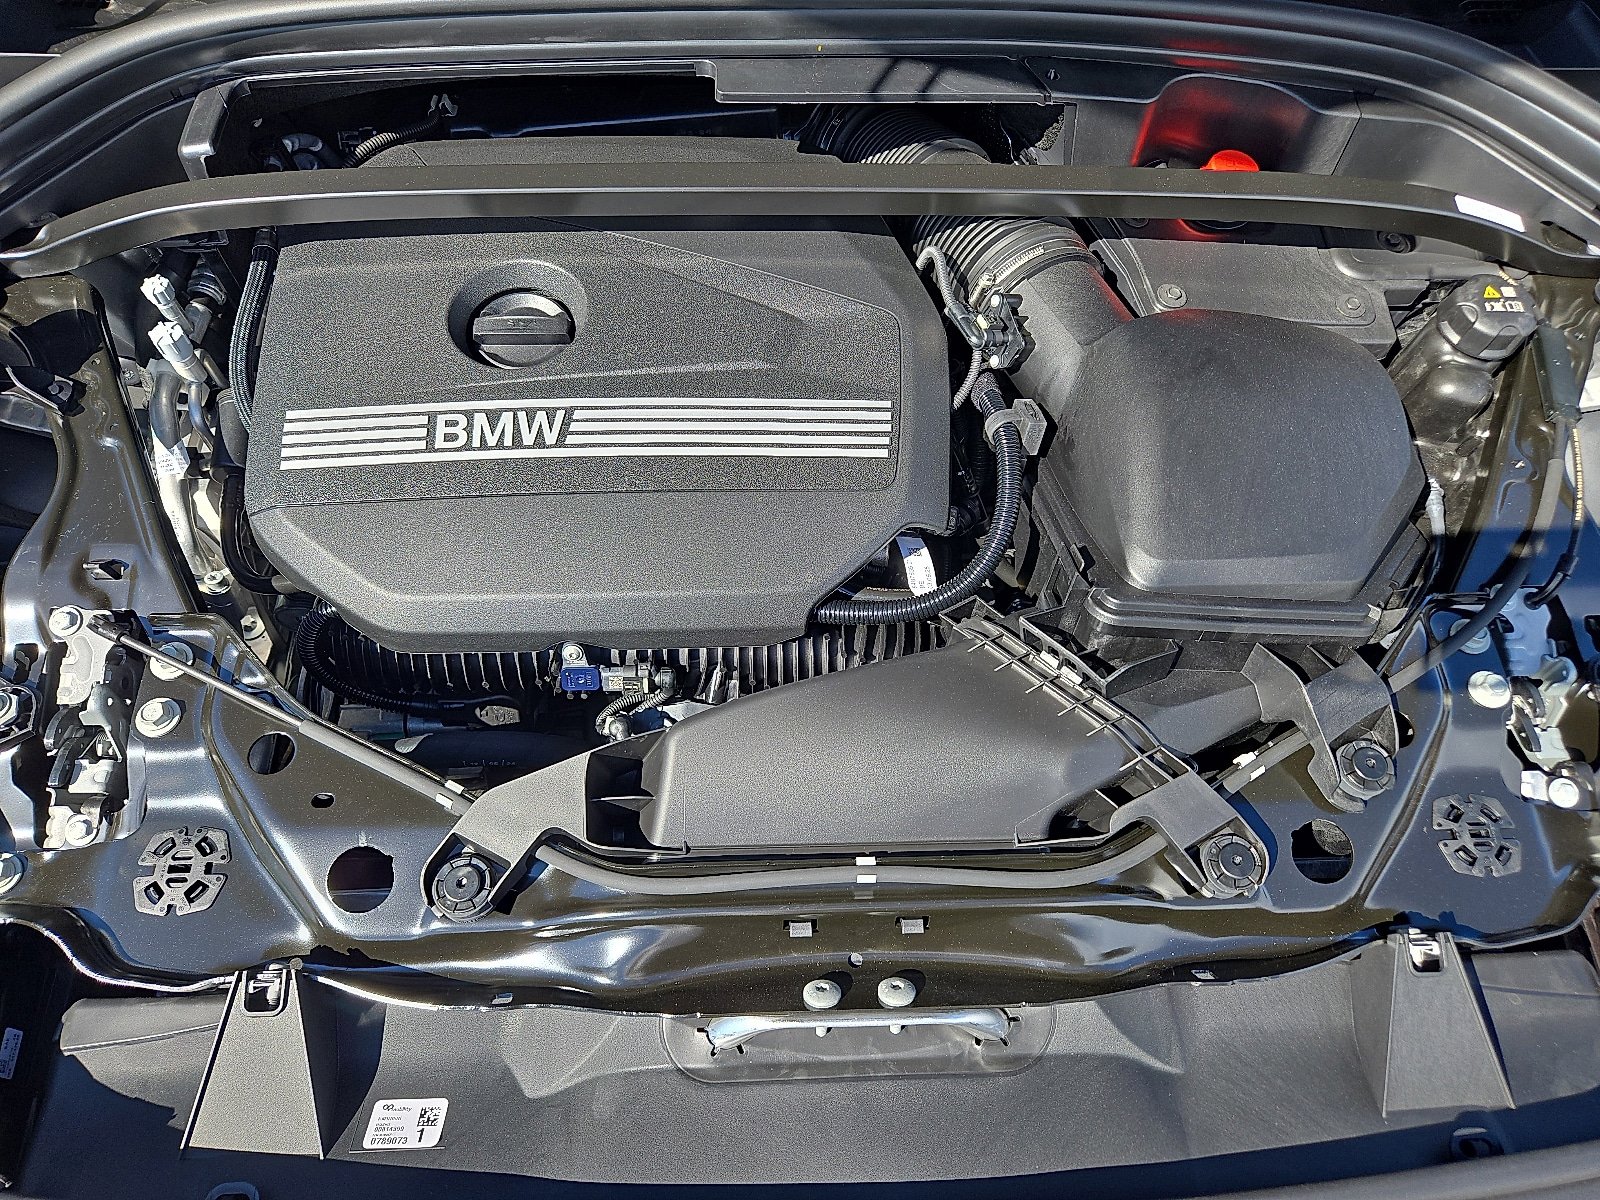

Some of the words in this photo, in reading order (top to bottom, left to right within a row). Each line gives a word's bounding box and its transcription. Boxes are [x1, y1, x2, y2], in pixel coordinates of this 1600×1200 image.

[434, 409, 566, 449] BMW
[370, 1136, 408, 1145] 0789073
[417, 1127, 425, 1143] 1
